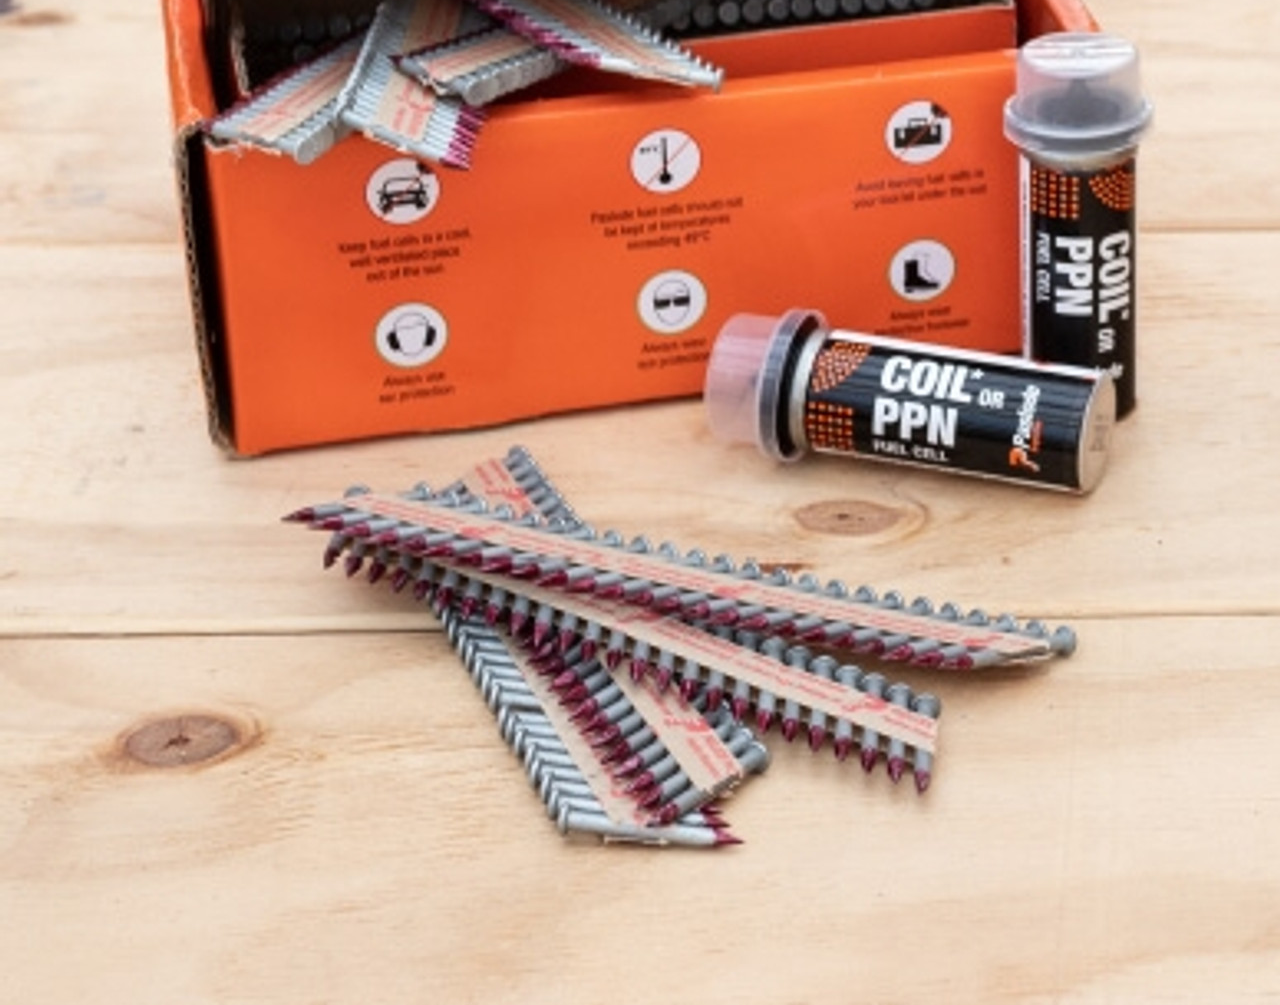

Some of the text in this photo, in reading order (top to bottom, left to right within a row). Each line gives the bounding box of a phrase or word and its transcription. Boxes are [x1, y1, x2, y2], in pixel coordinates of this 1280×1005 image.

[1055, 235, 1094, 316] PPN
[871, 397, 960, 448] PPN
[977, 387, 1006, 410] OR
[1012, 383, 1041, 449] Paslode
[873, 437, 950, 463] FUEL CELL
